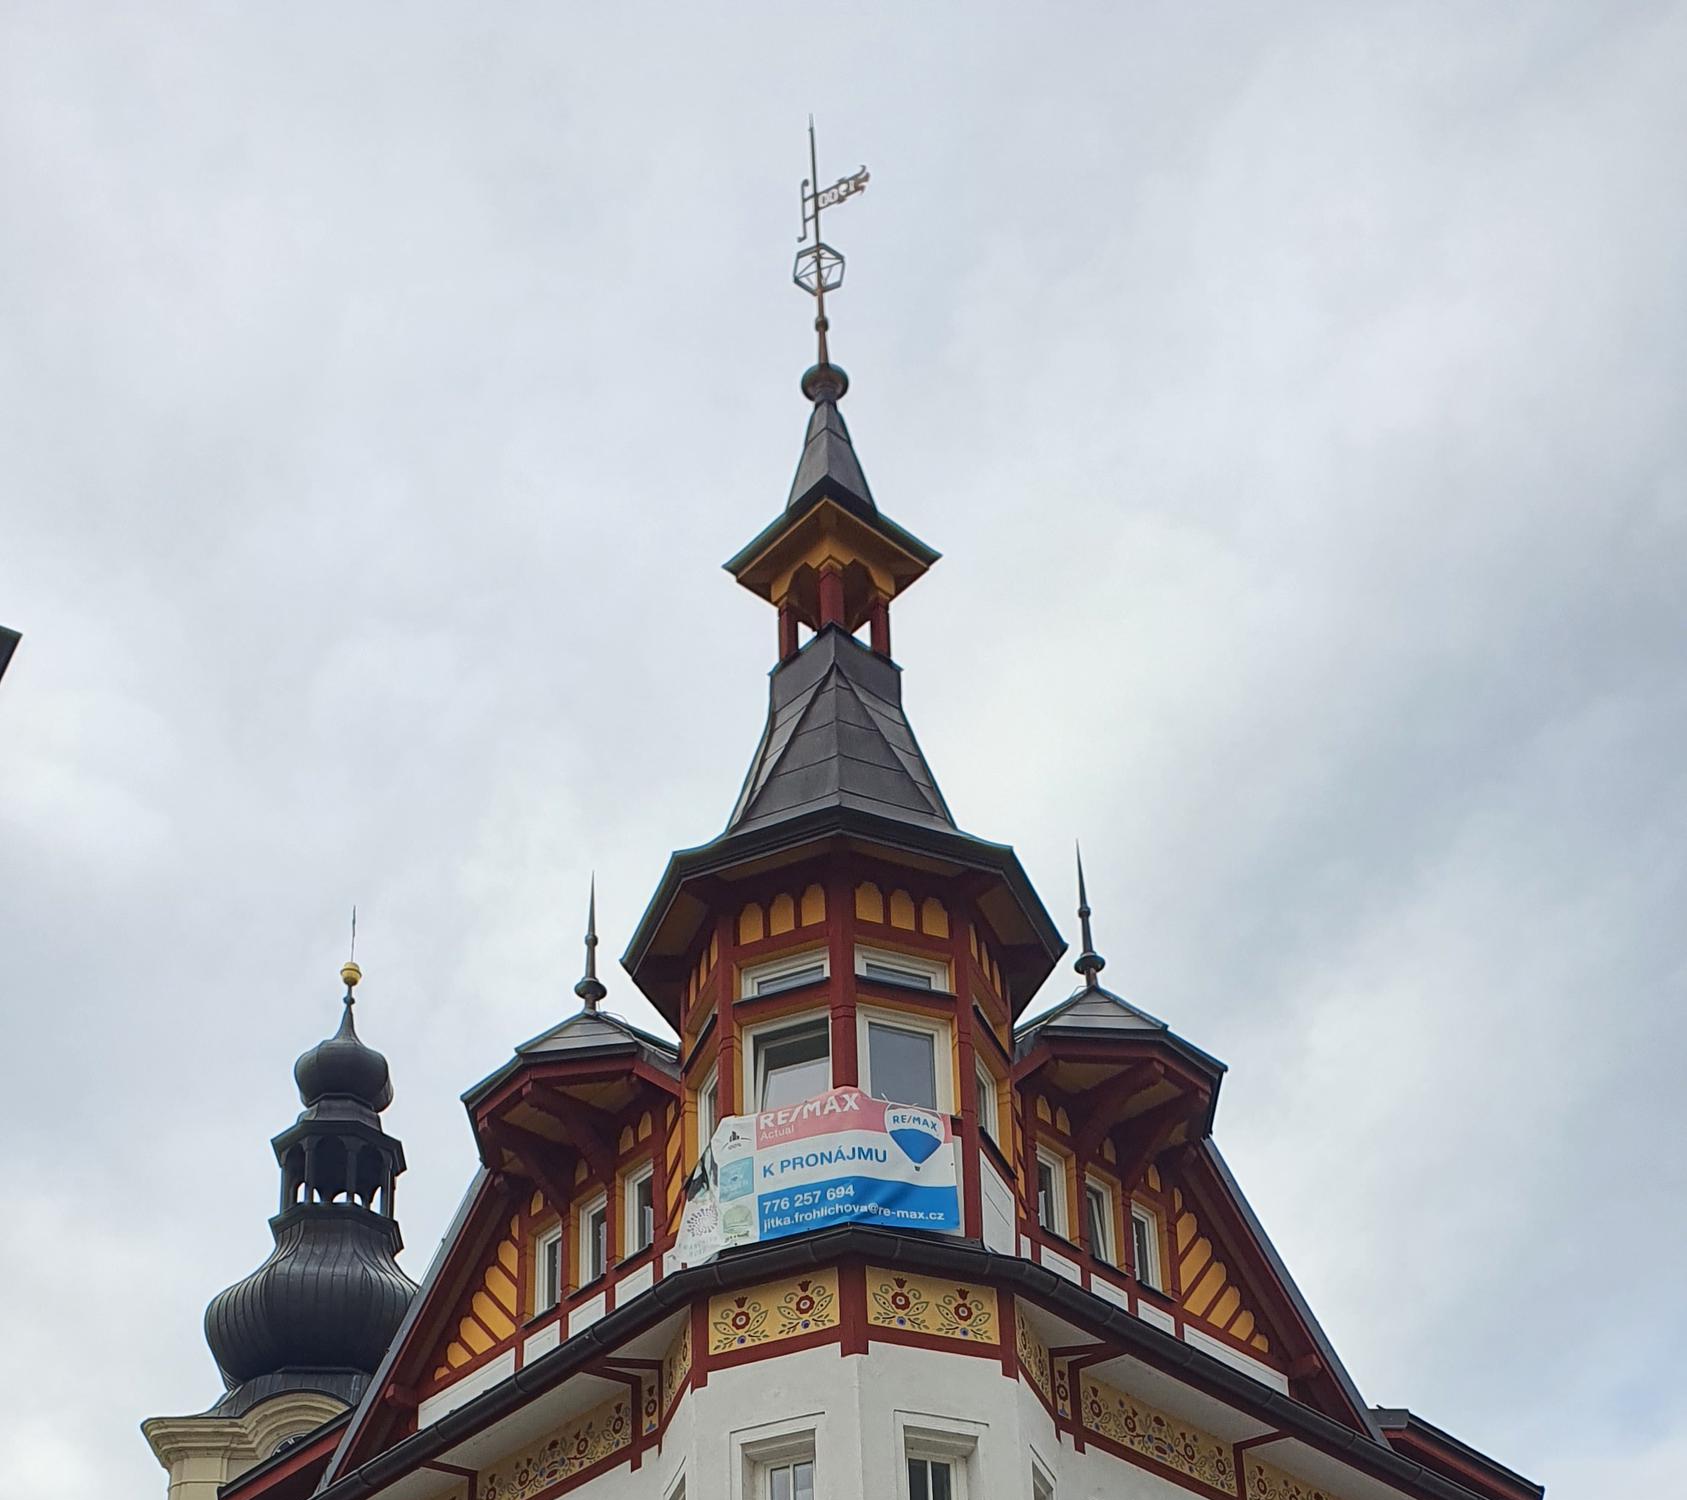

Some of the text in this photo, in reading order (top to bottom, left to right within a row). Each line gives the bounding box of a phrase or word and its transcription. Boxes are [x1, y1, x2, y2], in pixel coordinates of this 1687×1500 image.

[760, 1093, 860, 1130] RE/MAX
[892, 1114, 938, 1132] RE/MAX
[760, 1125, 794, 1141] Actual
[762, 1145, 887, 1178] K PRONÁJMU
[763, 1184, 855, 1215] 776 257 694
